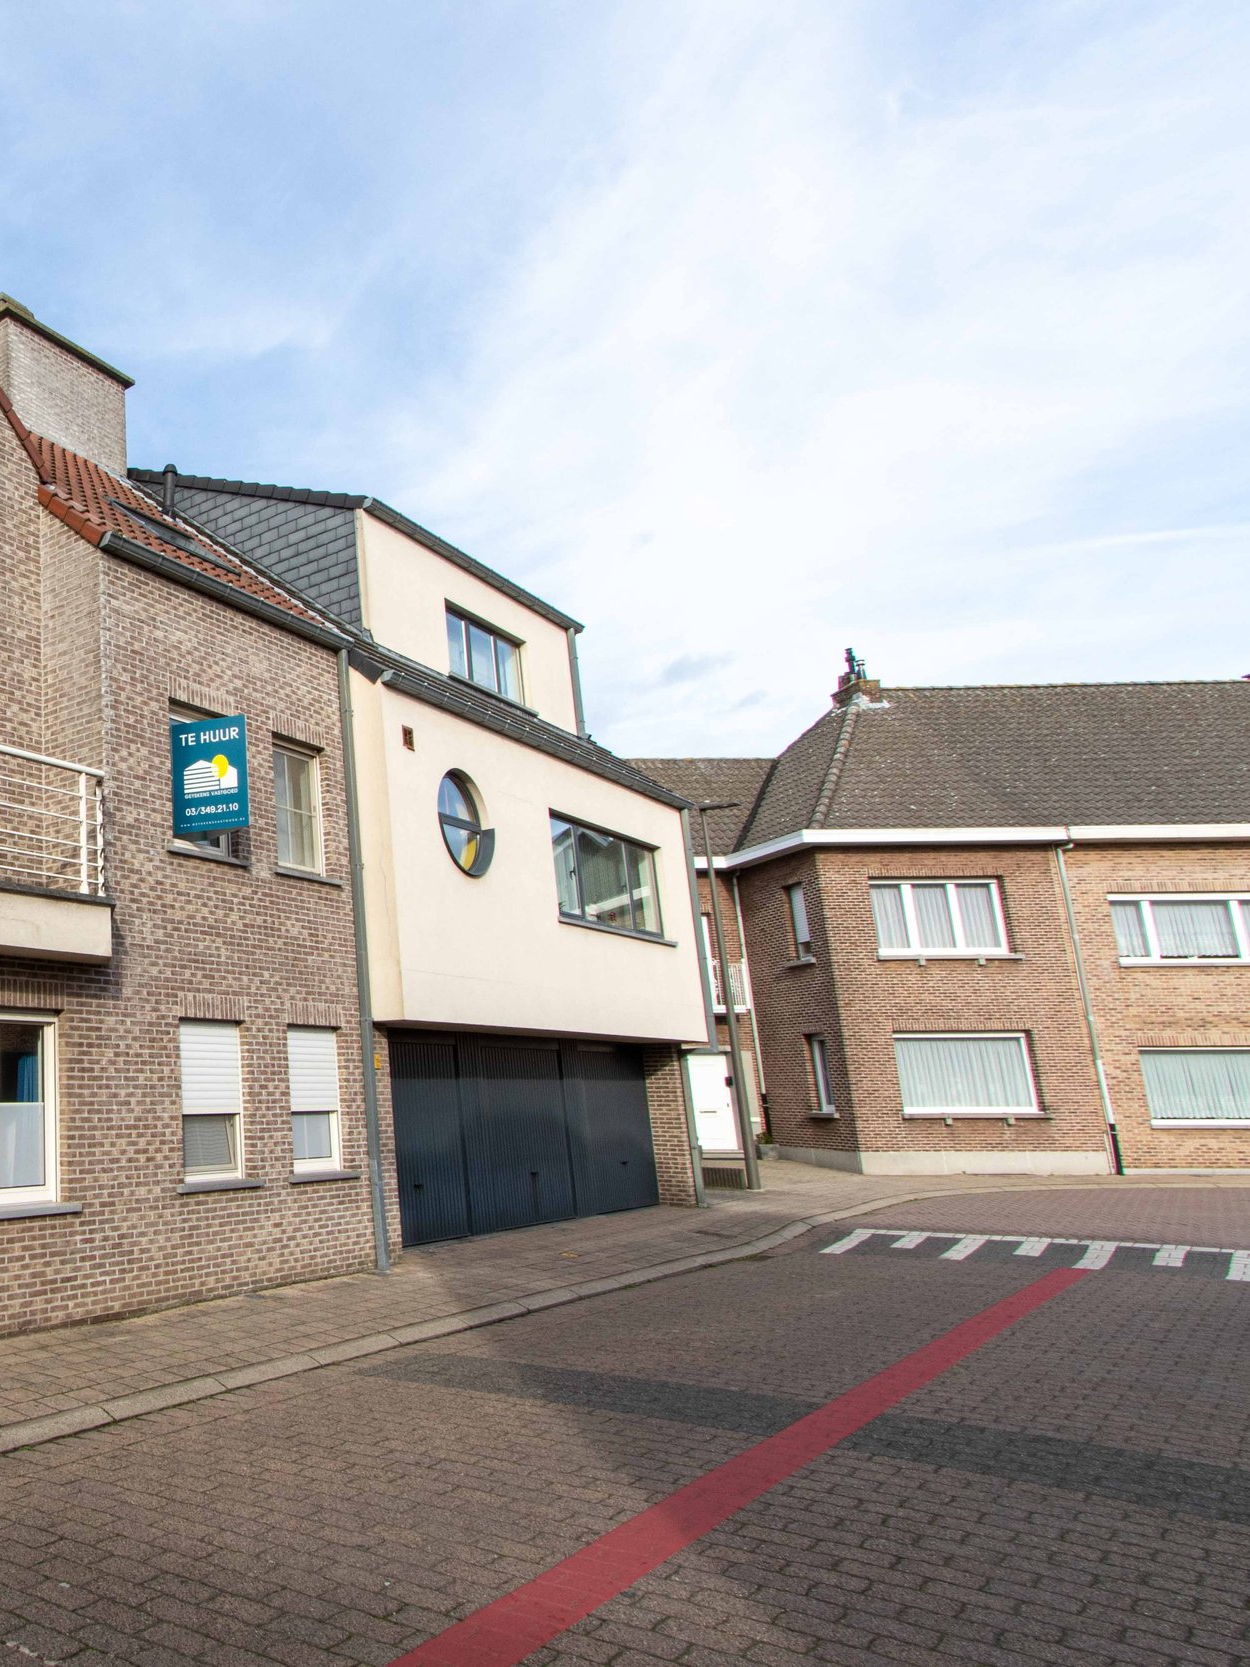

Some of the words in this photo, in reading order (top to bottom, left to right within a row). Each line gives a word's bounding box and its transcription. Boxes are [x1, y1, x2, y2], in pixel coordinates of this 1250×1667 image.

[179, 733, 196, 746] TE
[200, 727, 239, 744] HUUR
[211, 788, 239, 796] VASTGOED
[185, 802, 239, 816] 03/349.21.10
